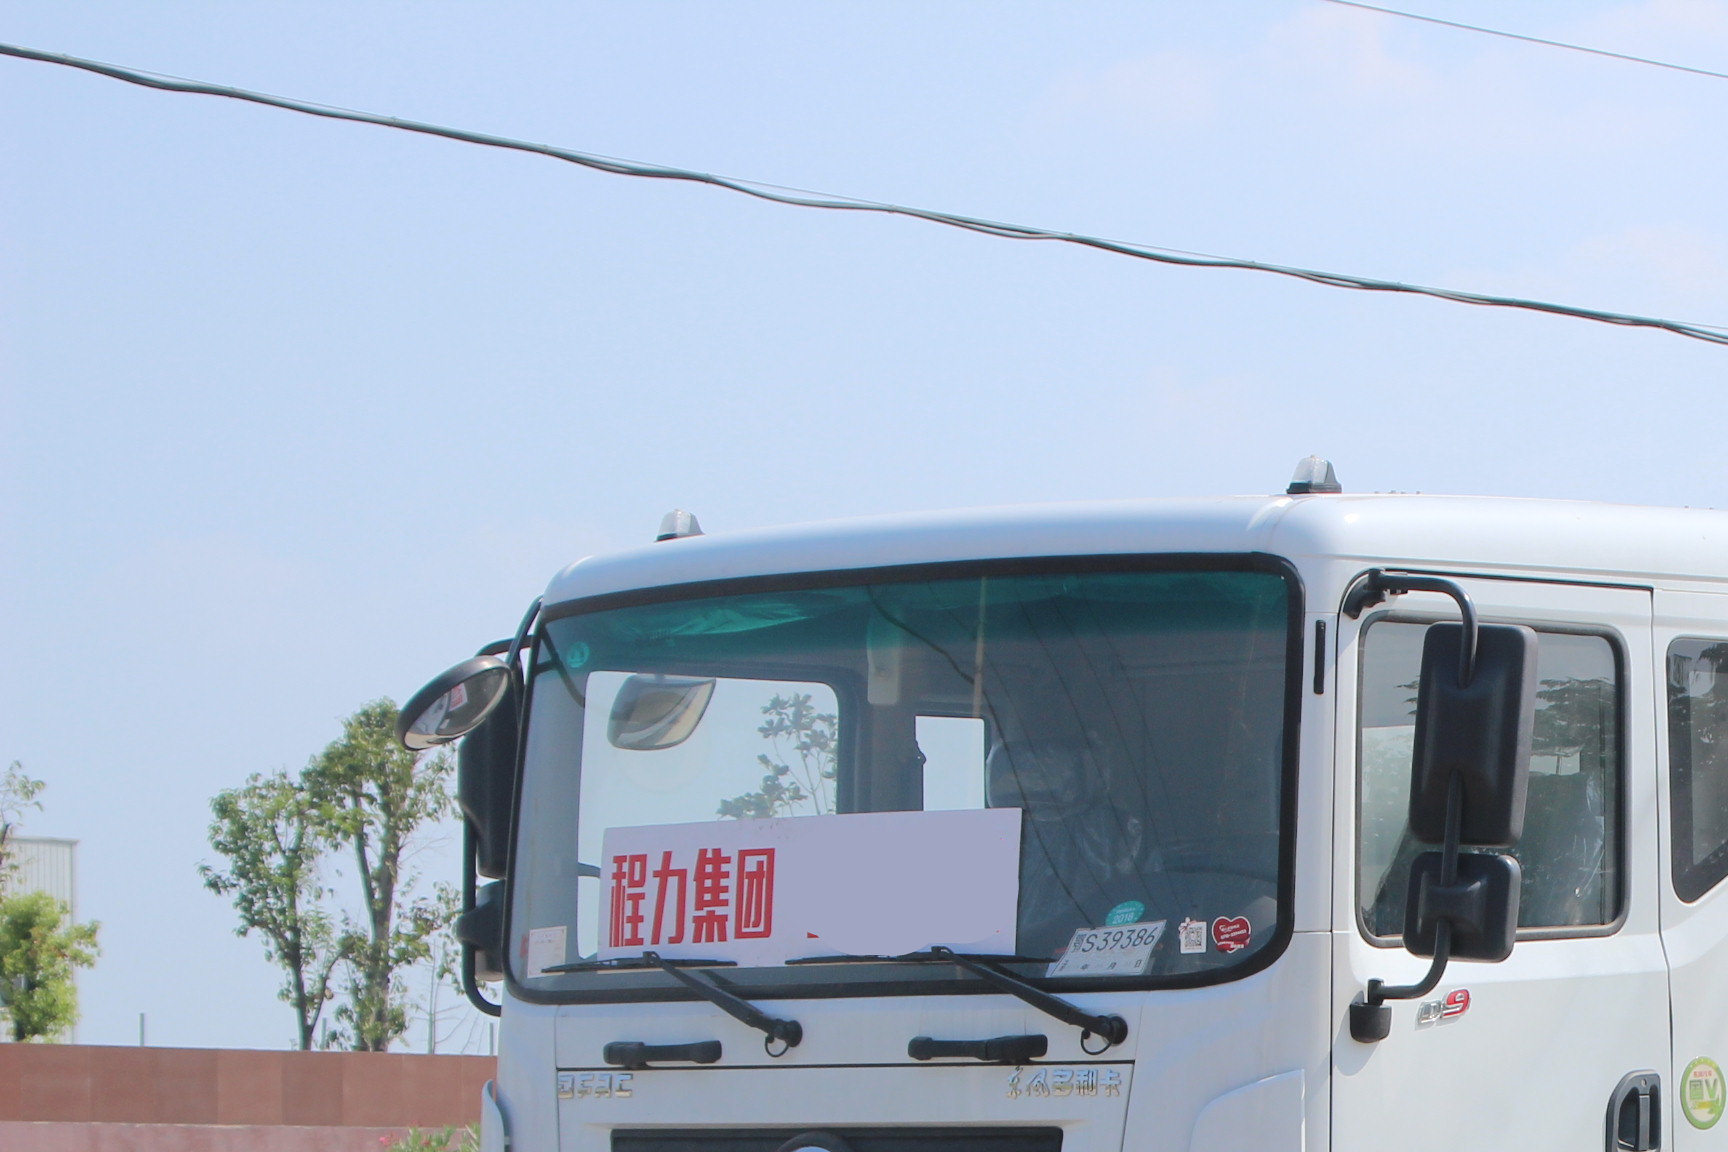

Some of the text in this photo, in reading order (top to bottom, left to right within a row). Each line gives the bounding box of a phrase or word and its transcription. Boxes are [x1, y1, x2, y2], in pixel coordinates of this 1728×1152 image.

[609, 847, 775, 947] 程力集团
[1007, 1065, 1121, 1099] 东风多利卡
